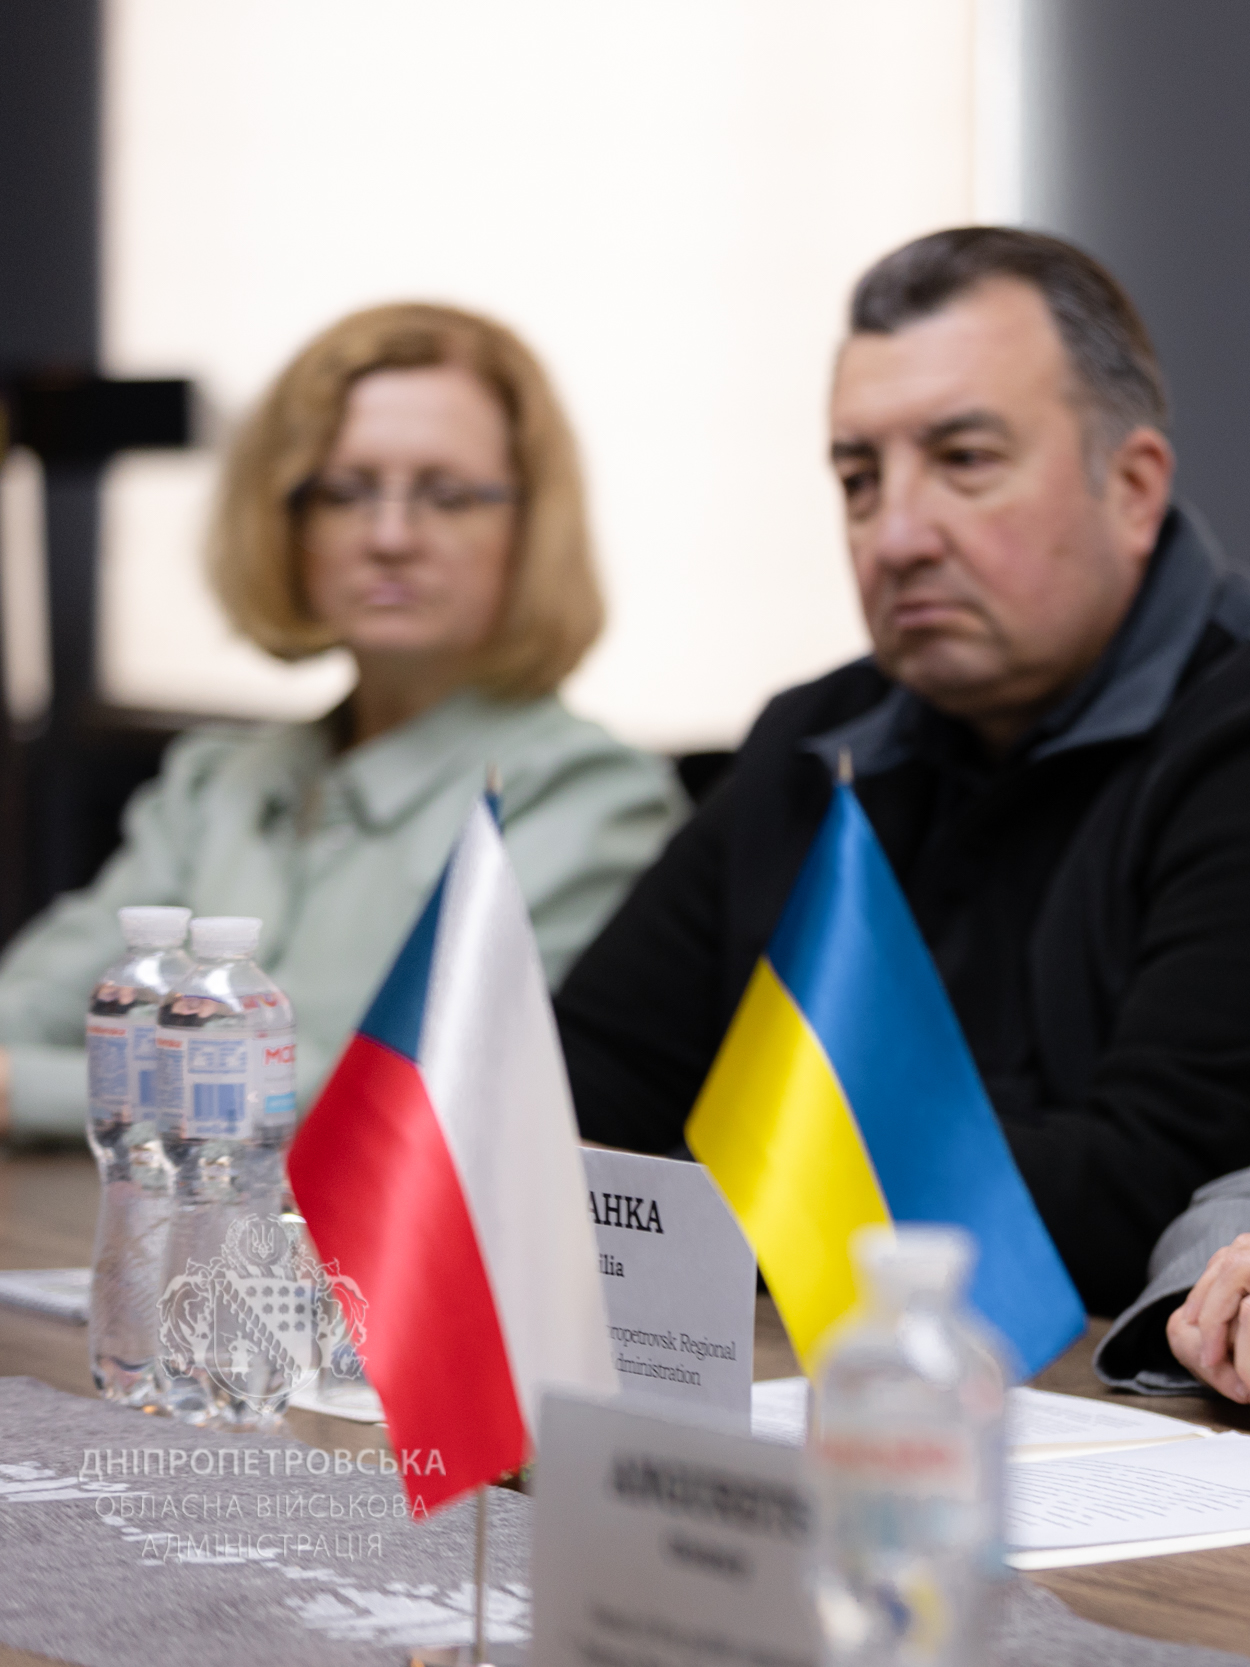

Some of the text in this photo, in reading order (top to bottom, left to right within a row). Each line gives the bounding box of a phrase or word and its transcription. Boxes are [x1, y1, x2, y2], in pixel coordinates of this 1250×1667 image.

[598, 1253, 624, 1278] ilia
[608, 1325, 737, 1362] ropetrovsk Regional
[615, 1352, 702, 1387] dministration
